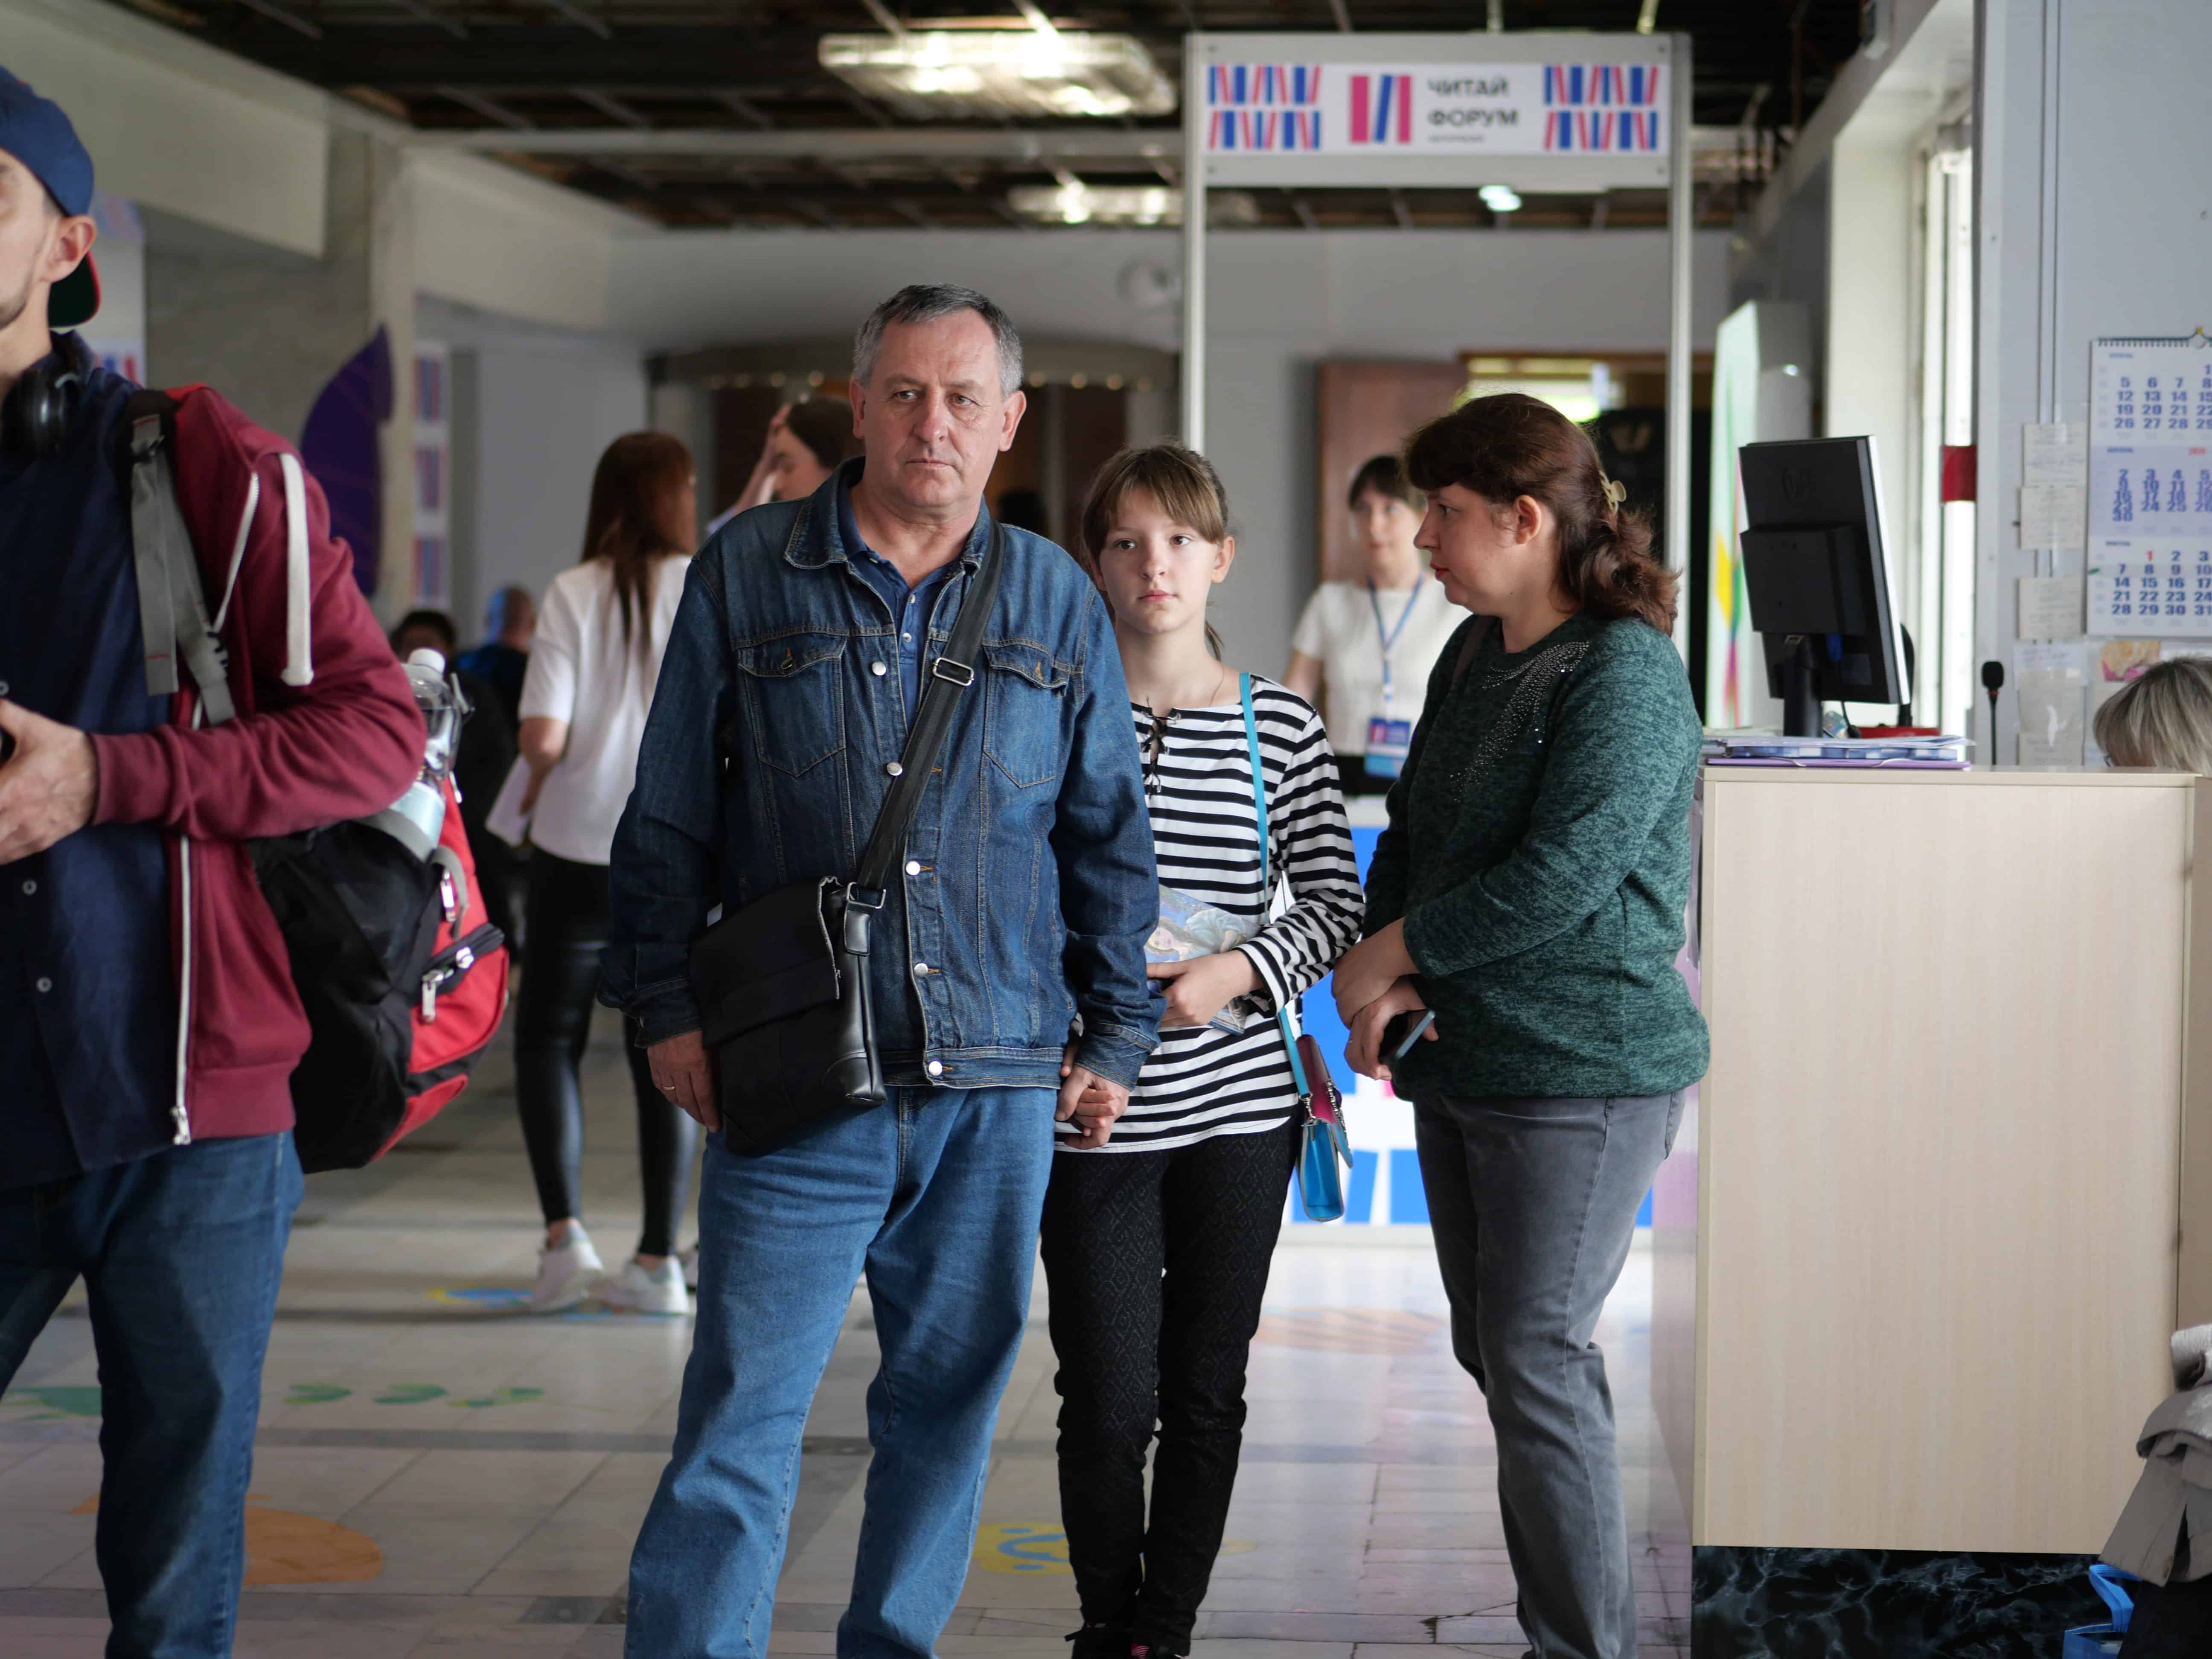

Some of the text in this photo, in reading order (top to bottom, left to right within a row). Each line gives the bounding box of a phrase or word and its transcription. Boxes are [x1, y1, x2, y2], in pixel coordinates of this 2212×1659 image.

[1428, 76, 1509, 97] ЧИТАЙ
[1427, 108, 1519, 127] ФОРУМ
[2203, 364, 2211, 375] 1
[2121, 377, 2212, 388] 5 6 7 8
[2117, 391, 2212, 402] 12 13 14 15
[2116, 405, 2212, 416] 19 20 21 22
[2115, 418, 2134, 428] 26
[2143, 418, 2161, 429] 27
[2168, 418, 2188, 429] 28
[2119, 469, 2210, 480] 2 3 4 5
[2142, 480, 2159, 491] 10
[2169, 480, 2184, 491] 11
[2143, 490, 2158, 501] 17
[2113, 500, 2132, 511] 23
[2141, 501, 2160, 511] 24
[2167, 501, 2187, 512] 25
[2113, 511, 2133, 521] 30
[2145, 550, 2209, 562] 1 2 3
[2118, 564, 2212, 575] 7 8 9 10
[2115, 577, 2212, 588] 14 15 16 17
[2114, 591, 2212, 602] 21 22 23 24
[2112, 604, 2212, 615] 28 29 30 31
